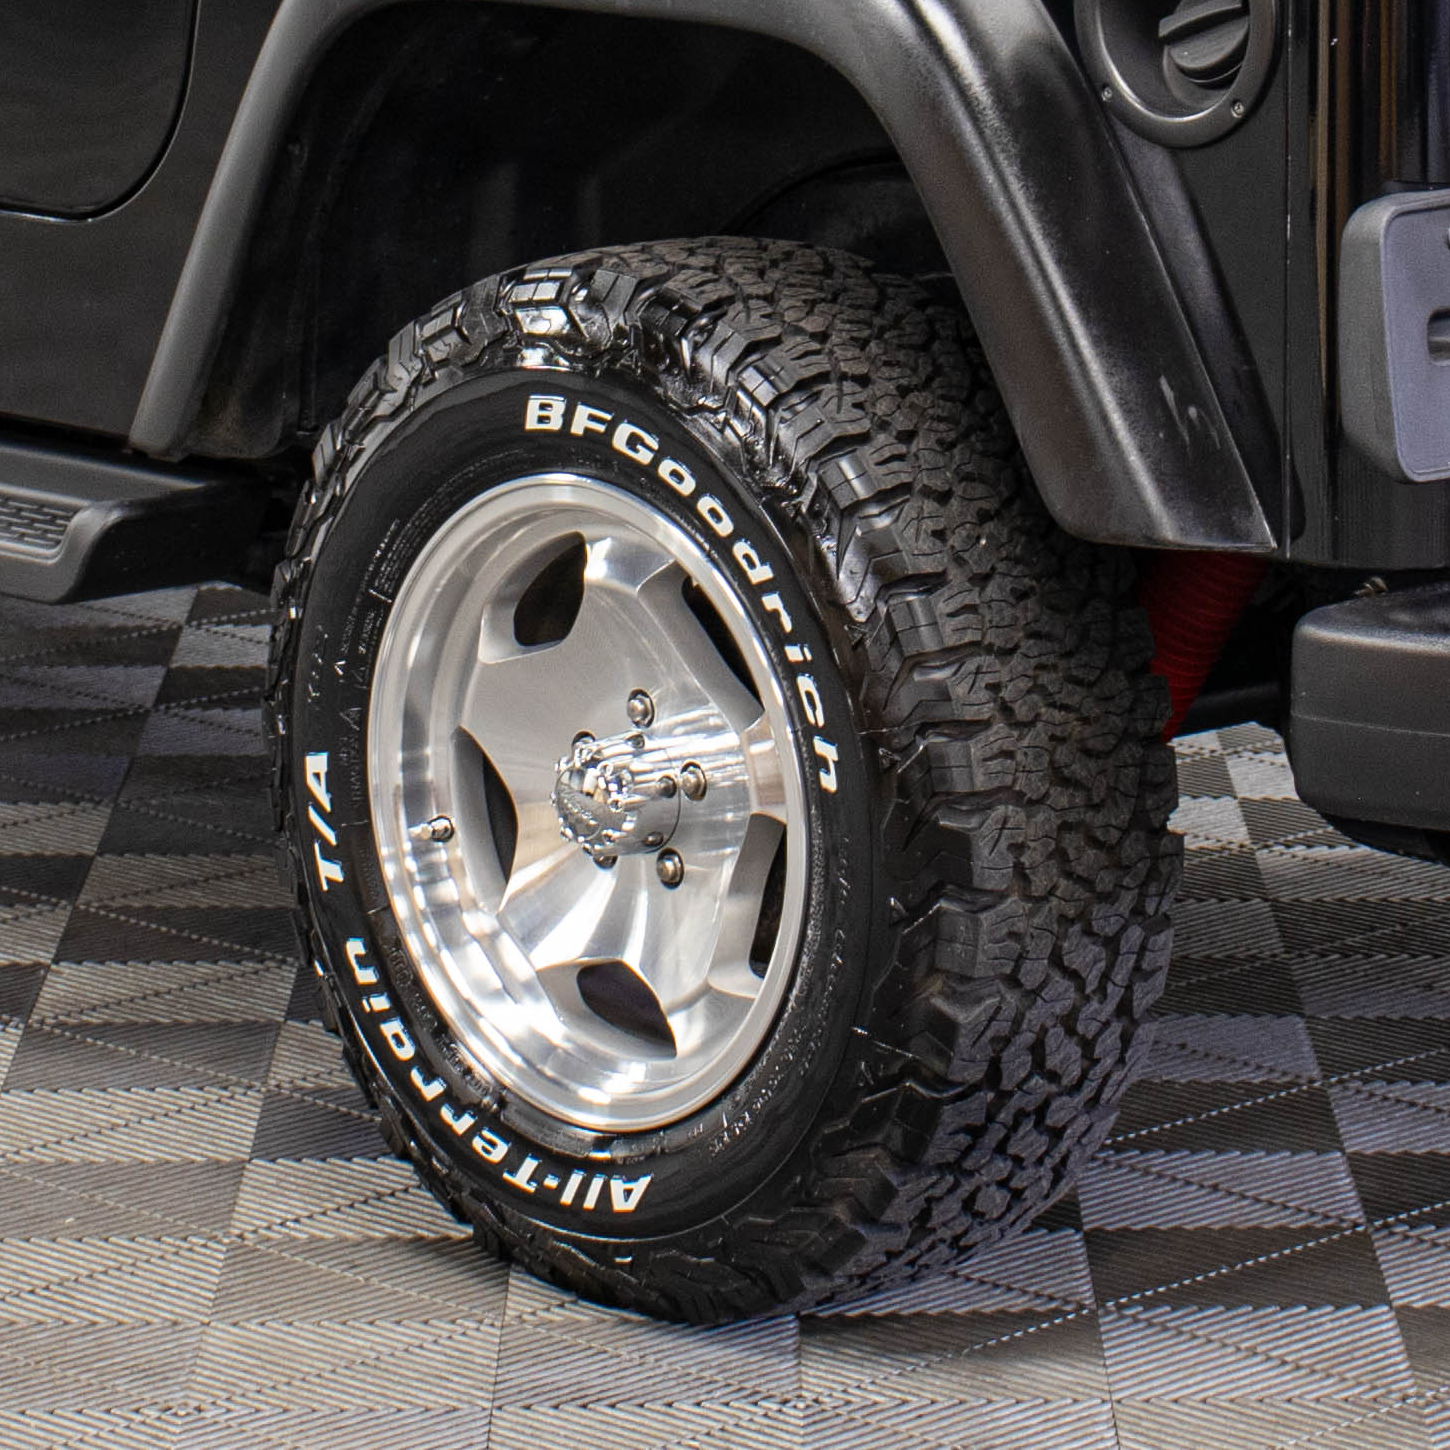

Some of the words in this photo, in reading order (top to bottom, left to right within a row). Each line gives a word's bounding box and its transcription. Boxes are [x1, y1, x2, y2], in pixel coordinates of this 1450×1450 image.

[524, 394, 839, 793] BFGoodrich
[303, 751, 345, 895] T/A
[344, 937, 653, 1214] All-Terrain
